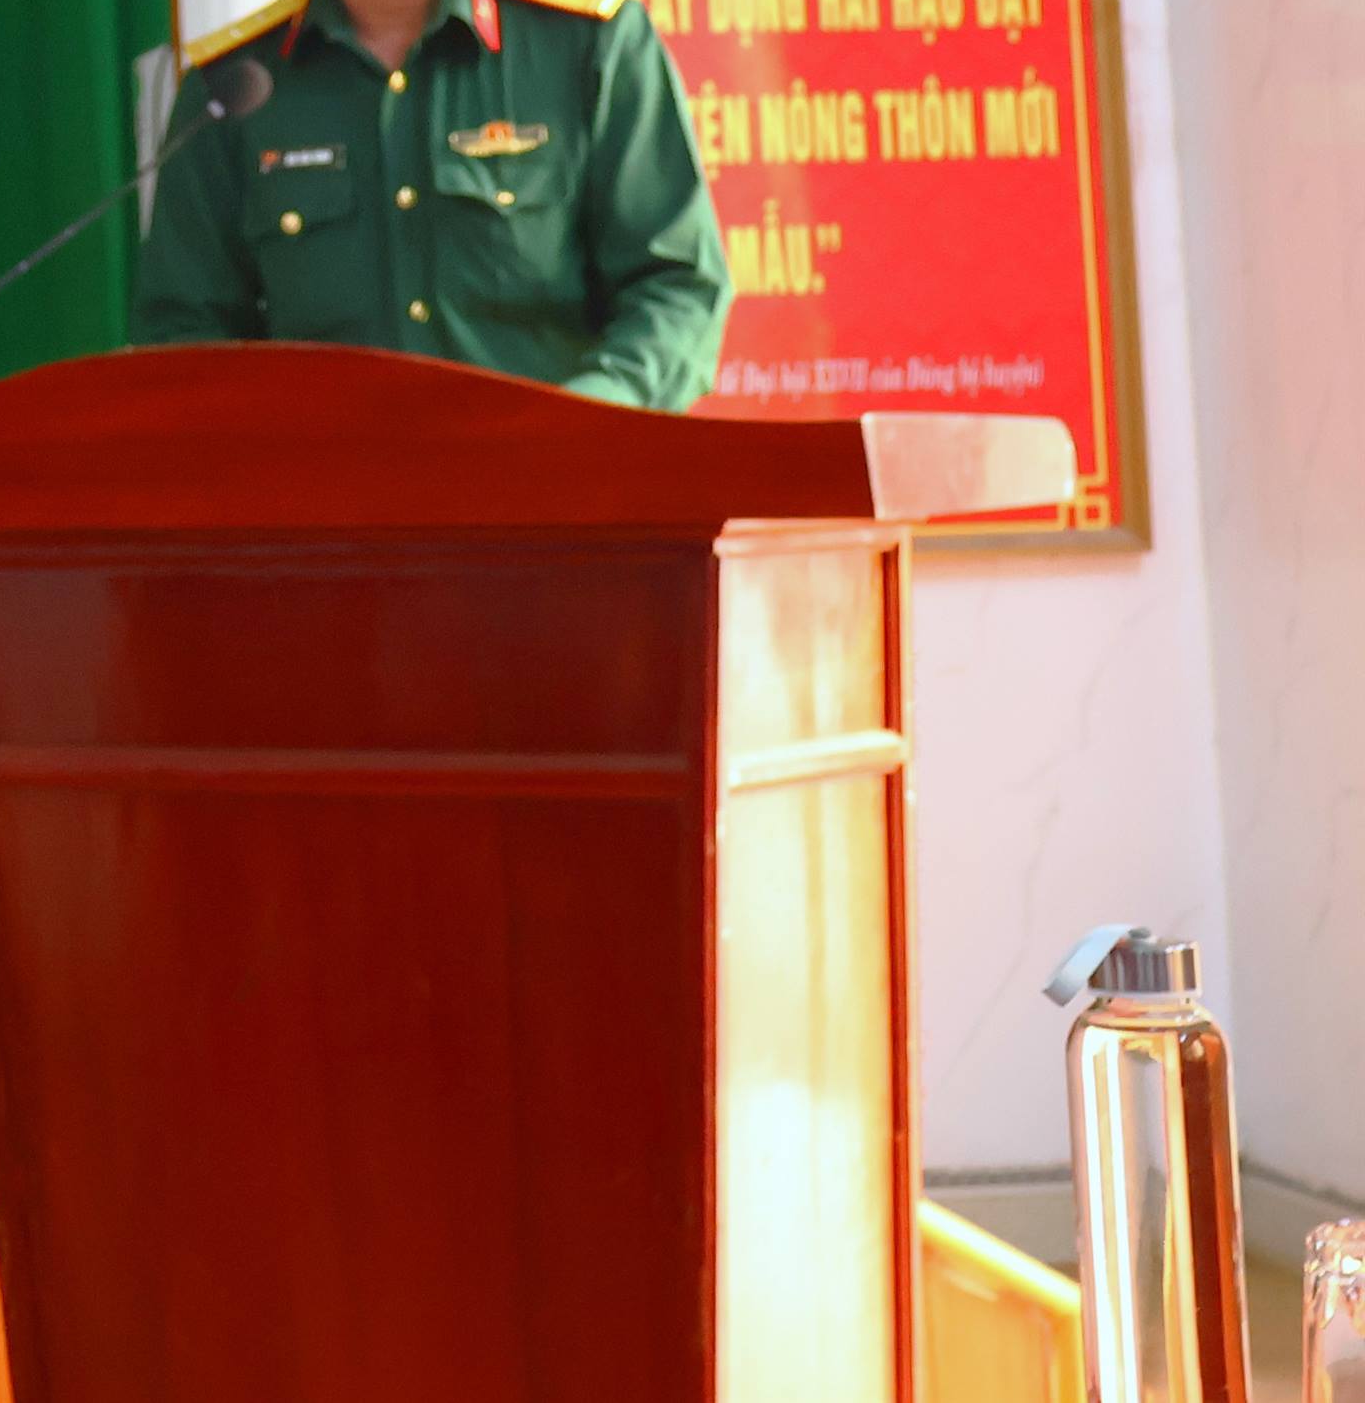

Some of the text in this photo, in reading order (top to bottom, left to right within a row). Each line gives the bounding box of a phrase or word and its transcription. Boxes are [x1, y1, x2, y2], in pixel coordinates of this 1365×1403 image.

[758, 77, 867, 165] NÔNG
[873, 74, 975, 160] THÔN
[981, 65, 1060, 159] MỚI
